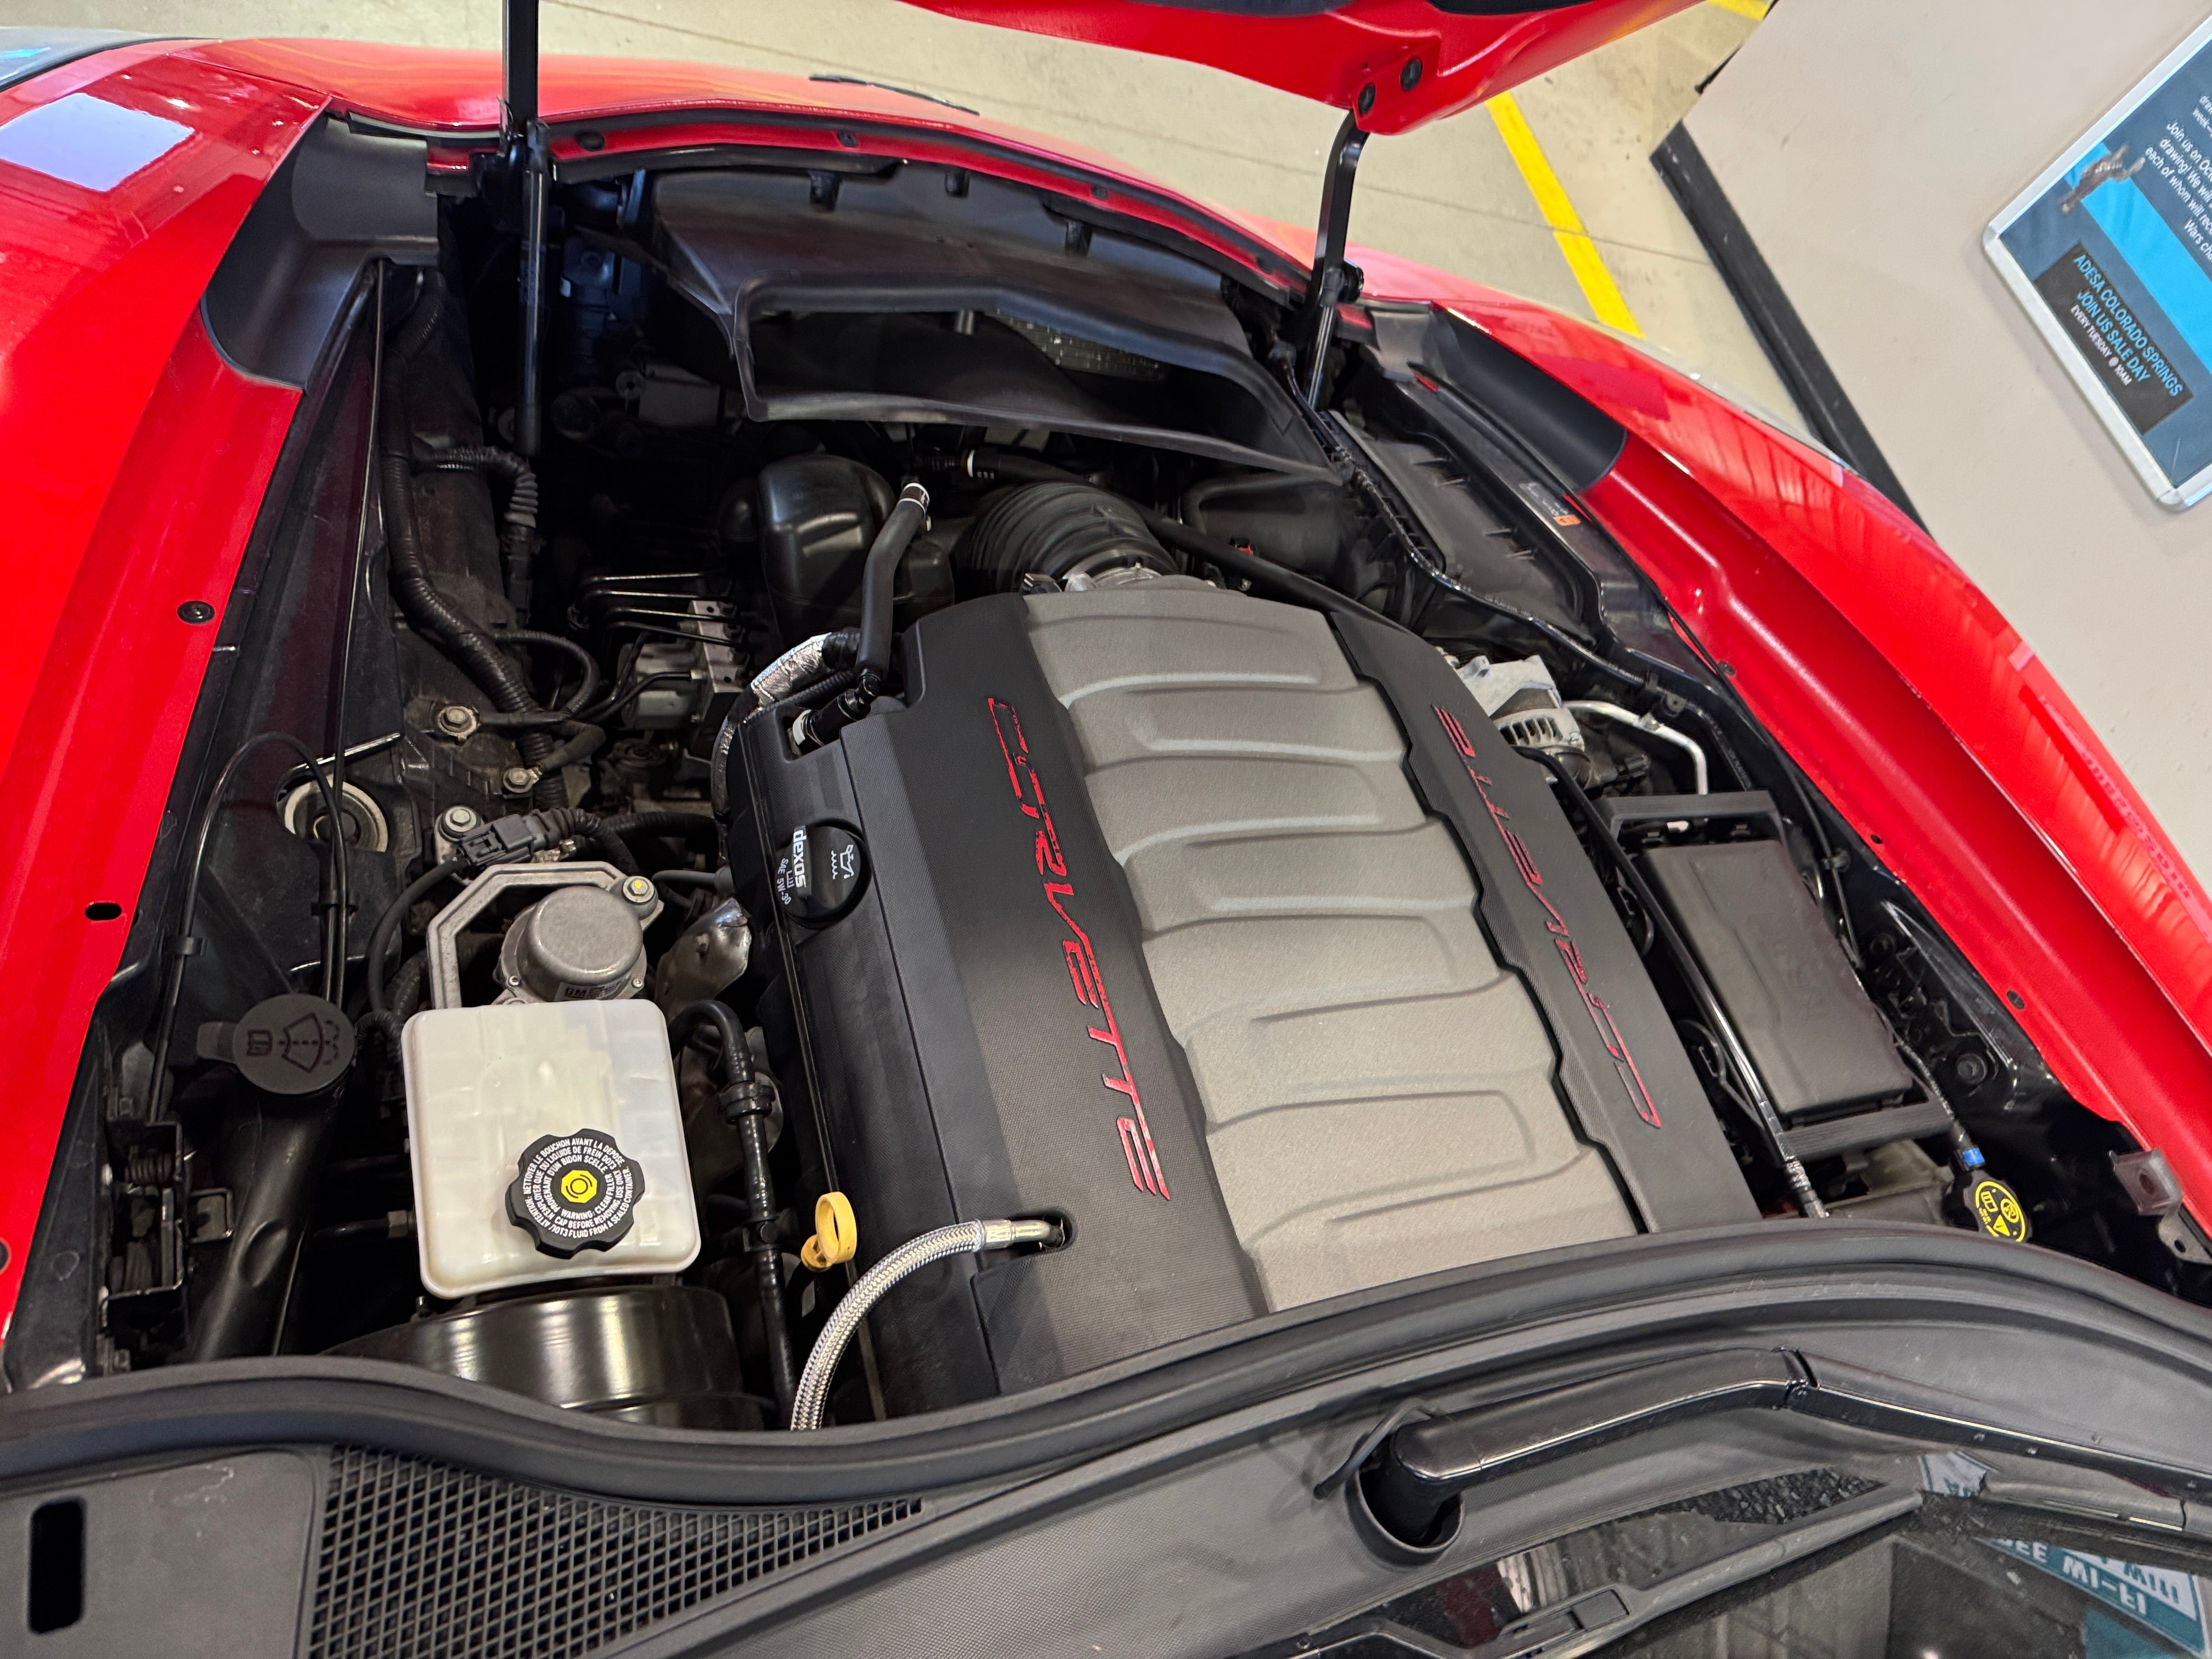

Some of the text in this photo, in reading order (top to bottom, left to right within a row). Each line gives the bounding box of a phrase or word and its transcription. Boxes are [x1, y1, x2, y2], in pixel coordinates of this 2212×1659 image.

[2166, 122, 2185, 142] Join
[2181, 138, 2193, 153] us
[2190, 149, 2202, 163] on
[2145, 146, 2164, 170] each
[2160, 166, 2175, 178] of
[2169, 175, 2191, 203] whom
[2188, 199, 2205, 217] will
[2159, 139, 2212, 203] drawing! We will
[2184, 219, 2204, 245] Wars
[2070, 304, 2091, 329] EVERY
[2087, 325, 2112, 357] TUESDAY
[2074, 255, 2183, 396] ADESA COLORADO SPRINGS
[2077, 291, 2151, 382] JOIN US SALE DAY
[793, 830, 807, 888] dexos
[776, 857, 792, 905] SAE 5W-30
[1431, 703, 1661, 1128] CORVETTE
[988, 697, 1170, 1200] CORVETTE
[533, 1154, 544, 1165] LE
[540, 1138, 571, 1158] BOUCHON
[571, 1137, 594, 1147] AVANT
[593, 1141, 603, 1150] LA
[523, 1163, 538, 1194] NETTOYER
[533, 1169, 545, 1184] QUE
[539, 1160, 550, 1171] DU
[546, 1147, 572, 1164] LIQUIDE
[583, 1146, 603, 1159] FREIN
[601, 1154, 617, 1170] DOT3
[542, 1175, 561, 1212] PROVENANT
[560, 1154, 582, 1166] BIDON
[613, 1170, 624, 1185] ONLY
[561, 1173, 614, 1220] WARNING: CLEAN FILLER
[615, 1186, 624, 1198] USE
[524, 1196, 551, 1228] ATTENTION:
[554, 1216, 568, 1226] CAP
[568, 1229, 589, 1238] FLUID
[589, 1223, 608, 1237] FROM
[611, 1202, 629, 1224] SEALED
[568, 1219, 595, 1229] BEFORE
